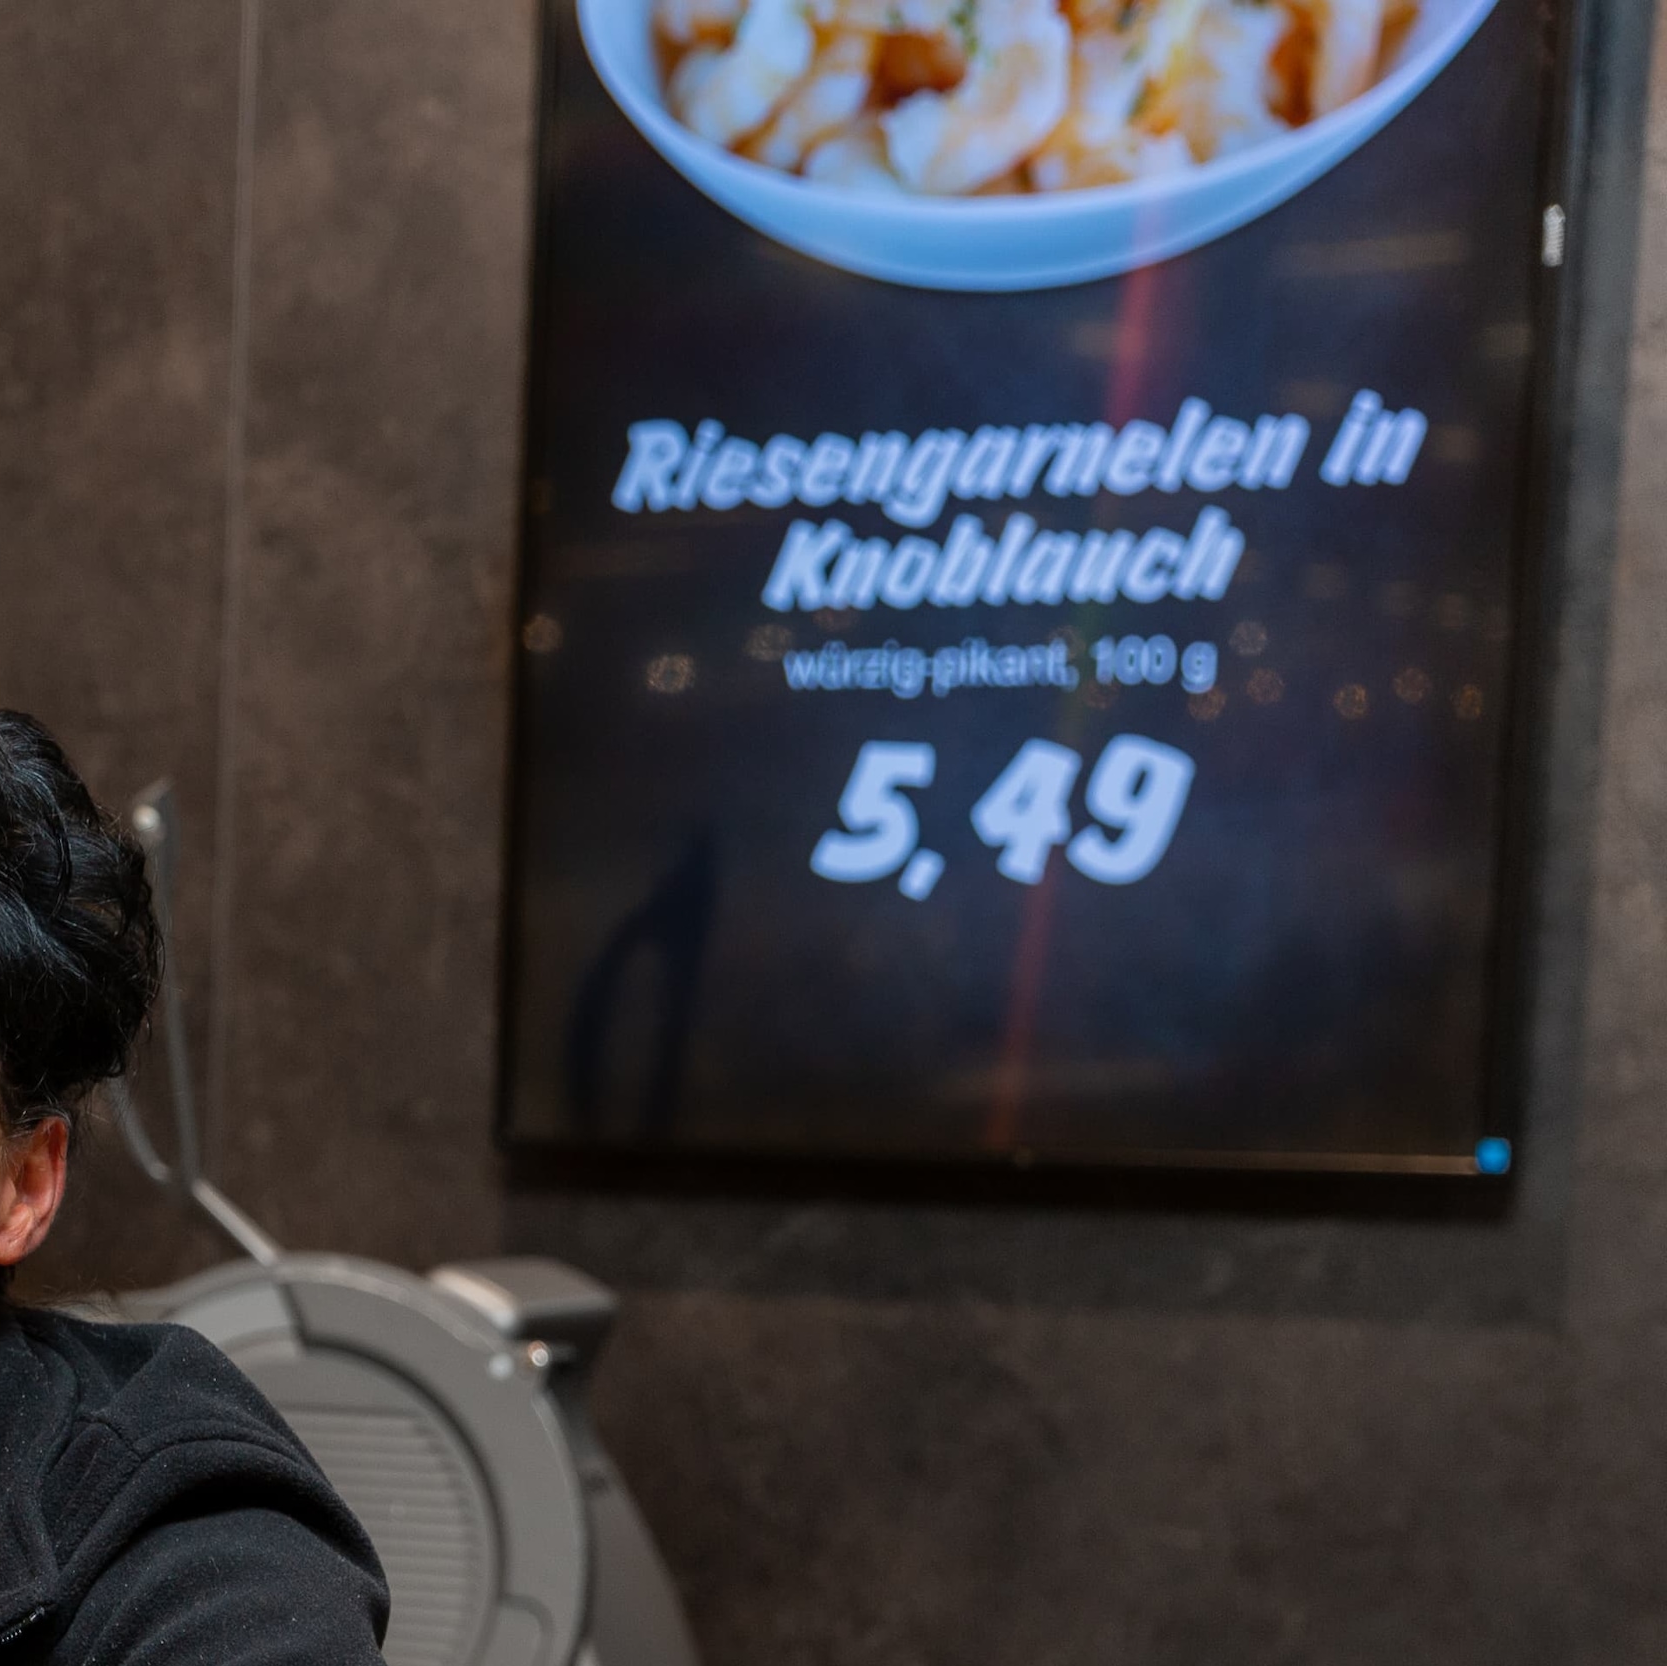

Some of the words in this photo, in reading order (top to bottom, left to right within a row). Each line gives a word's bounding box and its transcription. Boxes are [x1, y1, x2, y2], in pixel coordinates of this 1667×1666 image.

[611, 397, 1311, 528] Riesengarnelen
[1318, 388, 1428, 486] in
[761, 506, 1245, 612] Knoblauch
[1091, 633, 1177, 687] 100
[1180, 638, 1219, 694] g
[810, 733, 1196, 900] 5,49
